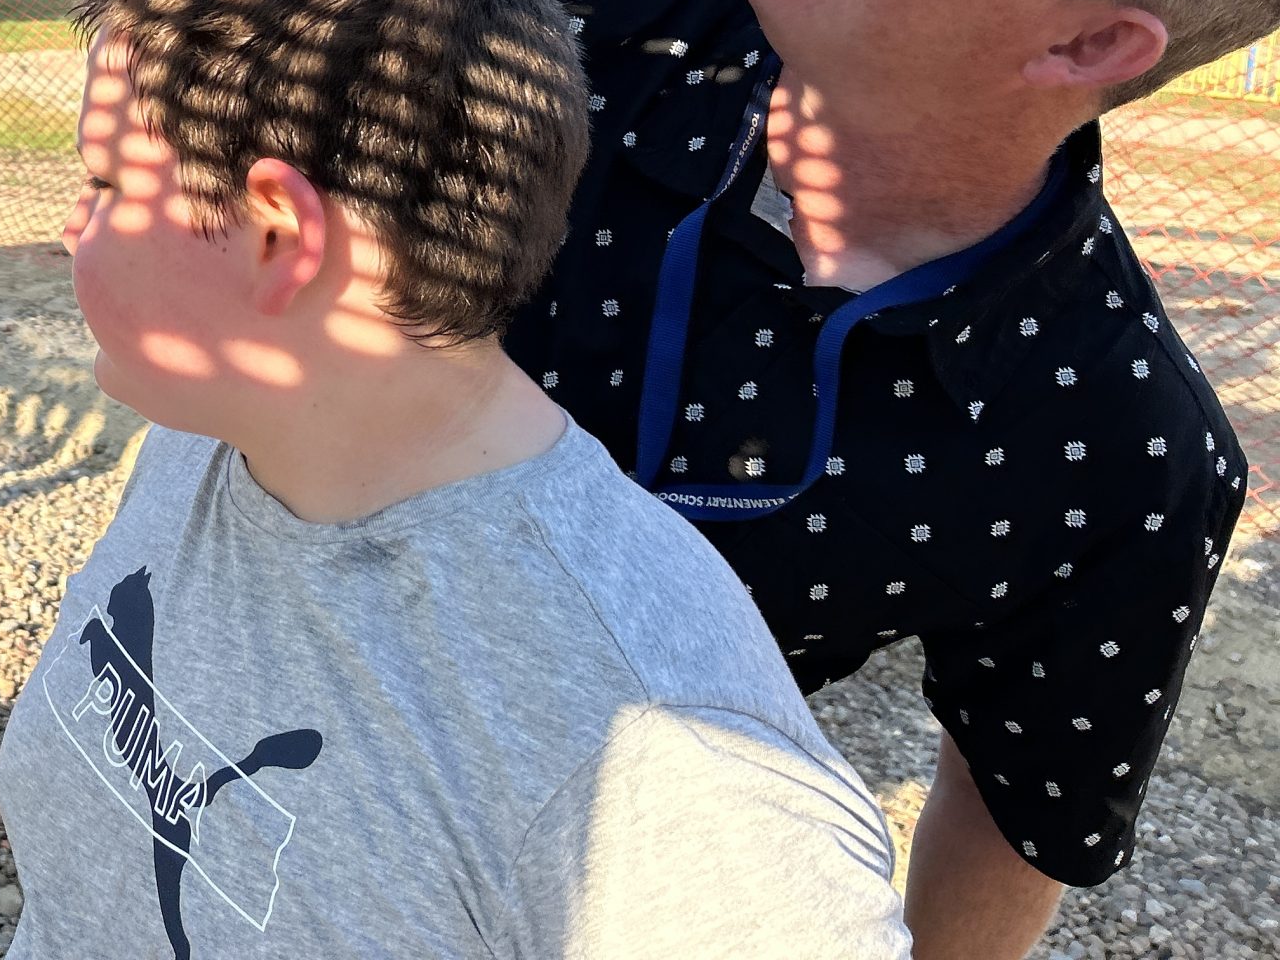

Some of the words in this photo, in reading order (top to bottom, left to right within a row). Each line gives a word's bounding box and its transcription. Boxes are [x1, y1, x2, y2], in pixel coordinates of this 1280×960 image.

[739, 112, 760, 158] SCHOOL
[654, 492, 704, 507] SCHOO
[706, 496, 786, 509] ELEMENTARY
[72, 661, 208, 846] PUMA
